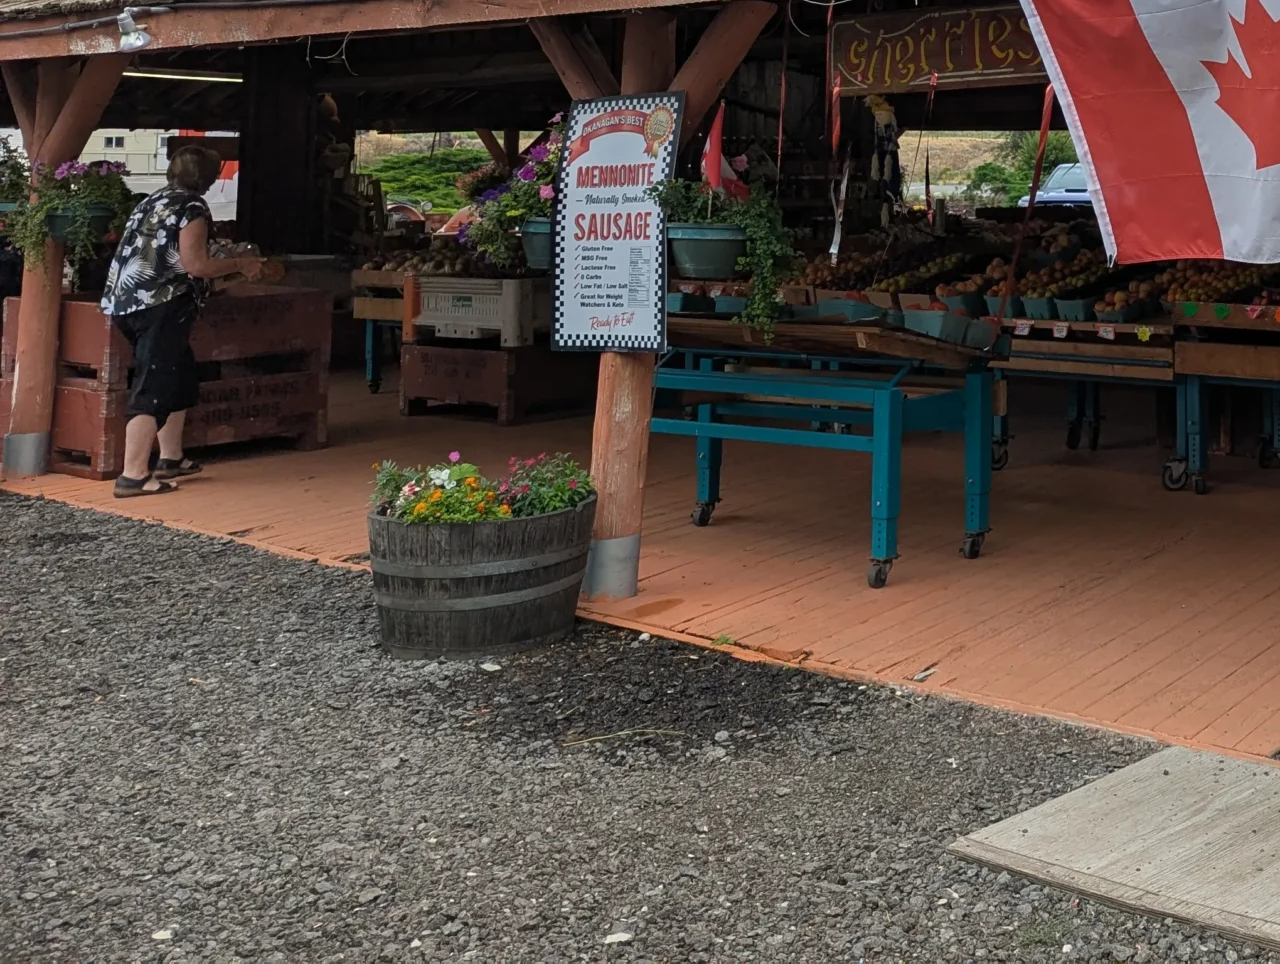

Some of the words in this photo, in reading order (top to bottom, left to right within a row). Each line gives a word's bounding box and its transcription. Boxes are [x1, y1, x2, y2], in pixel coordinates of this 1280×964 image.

[583, 116, 626, 135] OKANAGAN'S
[627, 115, 644, 125] BEST
[575, 163, 656, 189] MENNONITE
[584, 194, 619, 207] Naturally
[621, 193, 647, 204] Smoked
[573, 212, 652, 241] SAUSAGE
[589, 315, 613, 332] Ready
